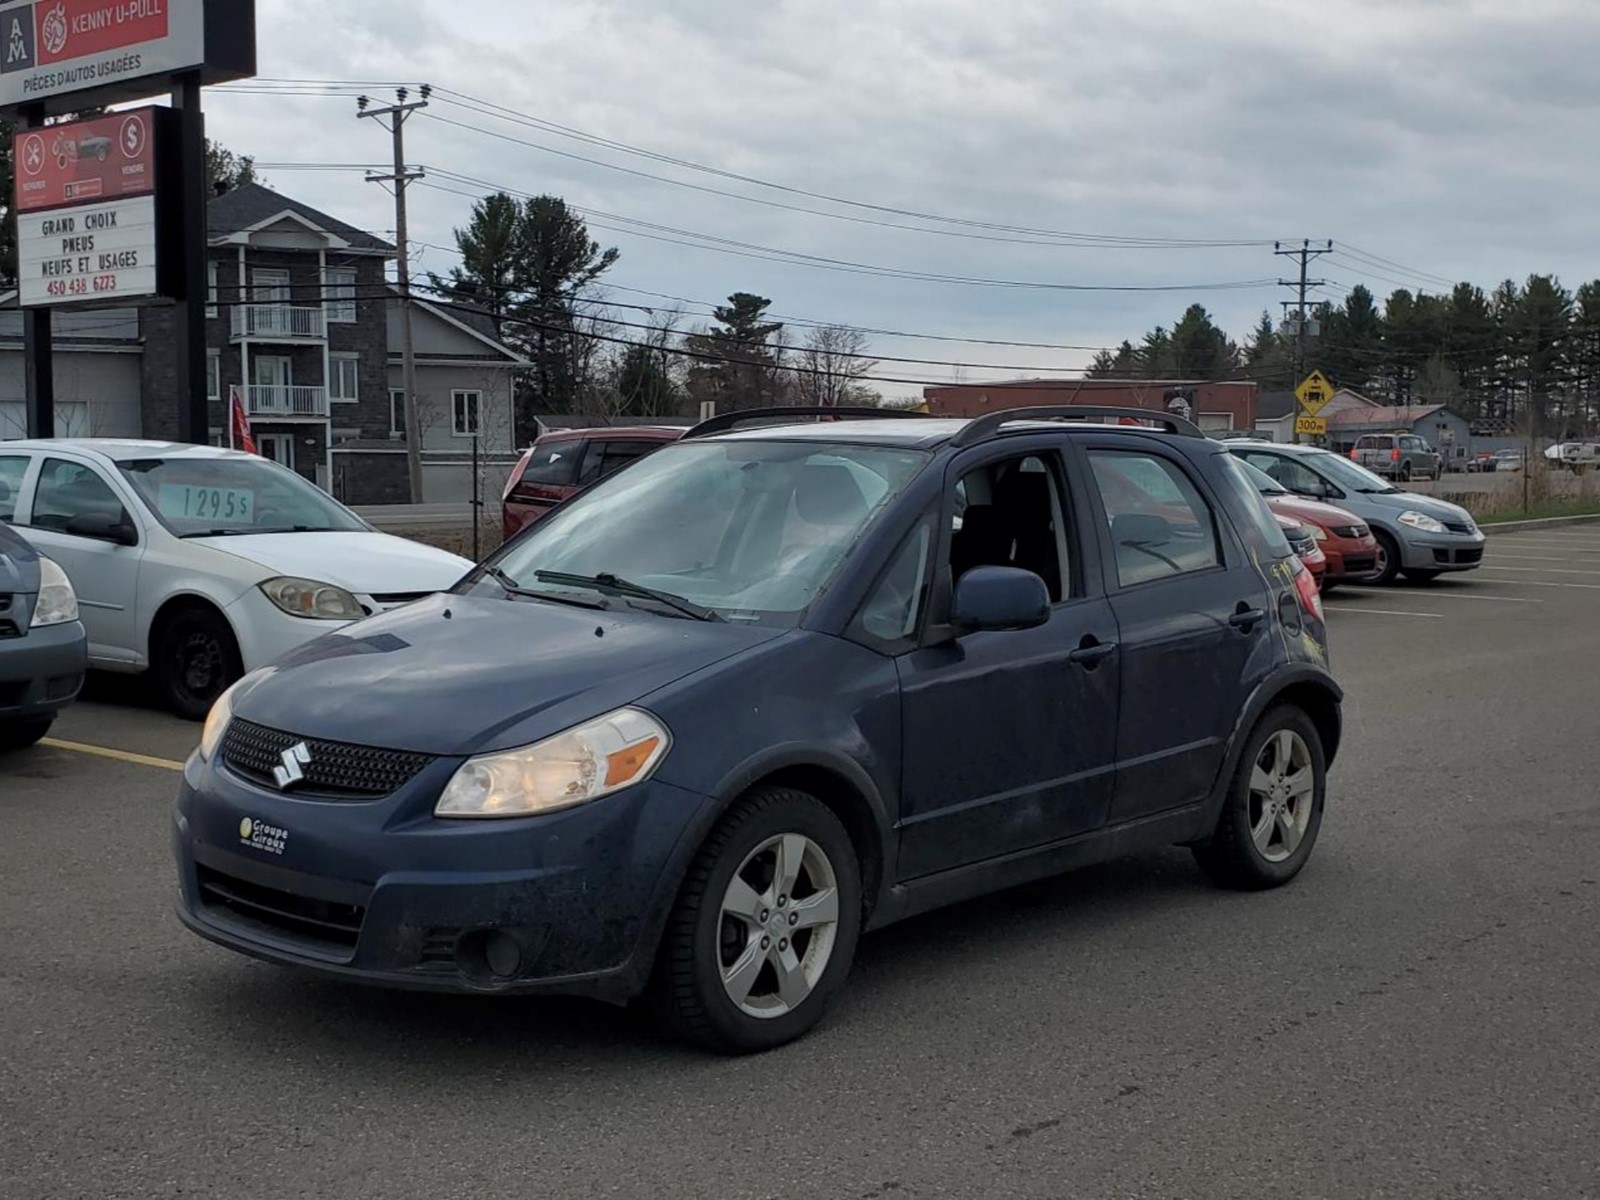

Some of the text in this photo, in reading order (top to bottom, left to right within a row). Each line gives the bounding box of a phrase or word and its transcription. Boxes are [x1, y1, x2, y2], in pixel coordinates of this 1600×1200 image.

[72, 0, 162, 34] KENNY U-PULL
[23, 54, 142, 93] PIÈCES D'AUTOS USAGÉES
[42, 211, 117, 236] GRAND CHOIX
[62, 235, 95, 254] PNEUS
[42, 250, 138, 277] NEUFS ET USAGES
[47, 274, 117, 296] 450 438 6273
[252, 831, 286, 850] Giroux
[253, 819, 289, 840] Groupe
